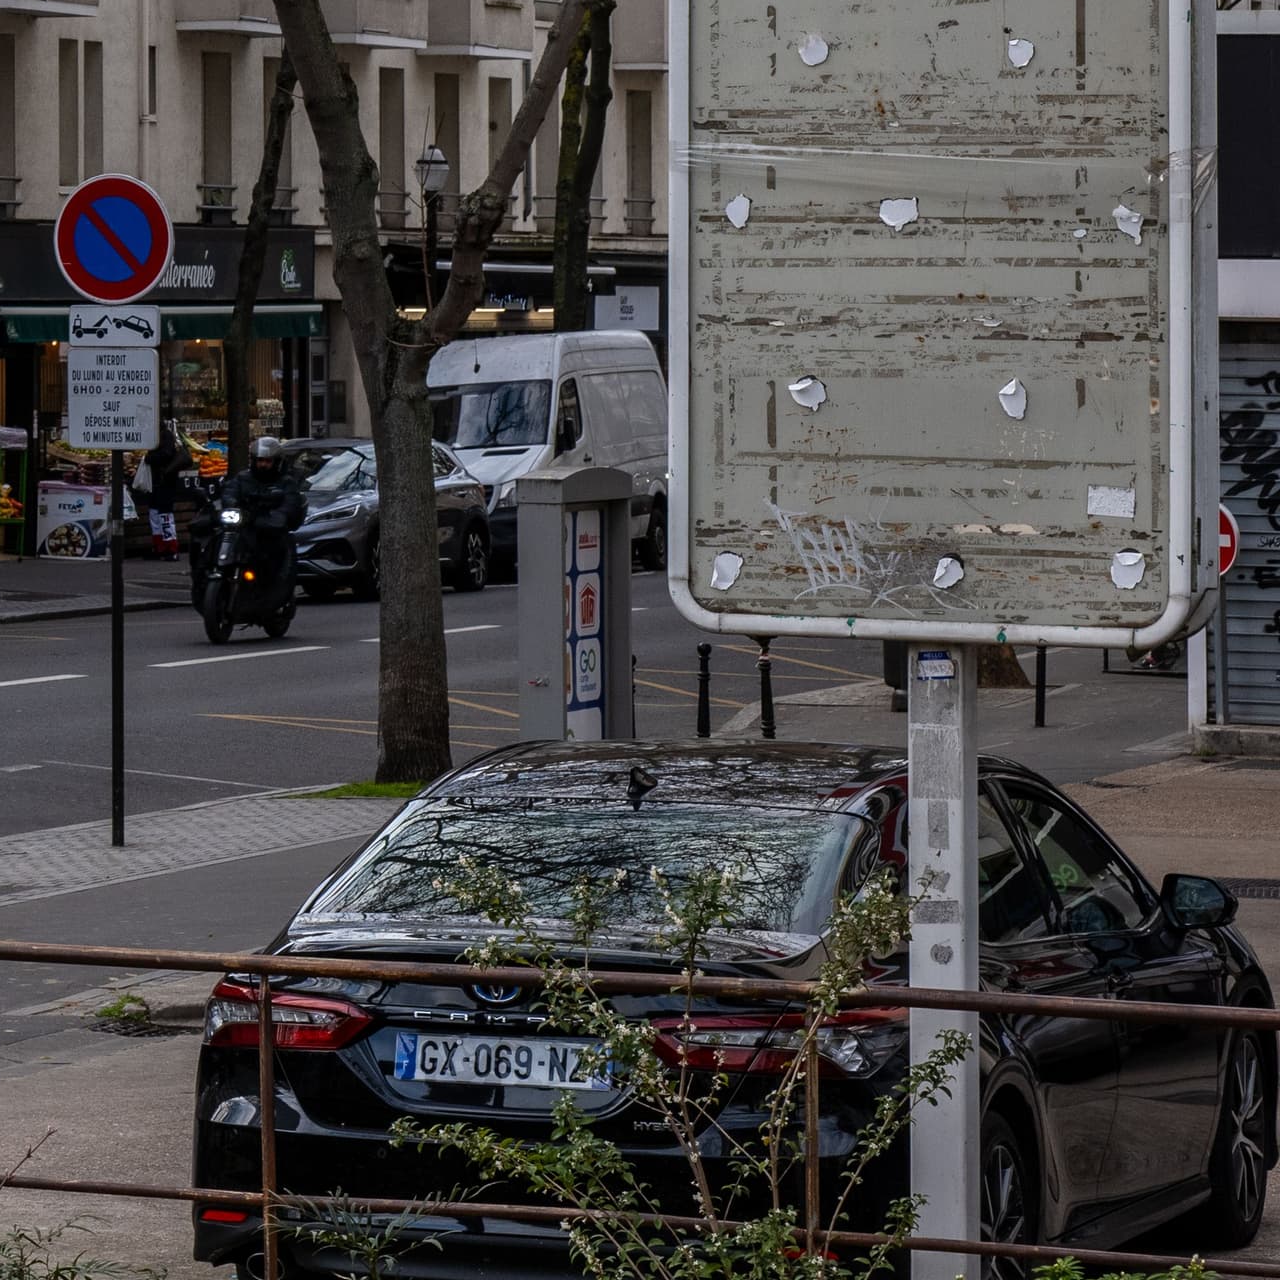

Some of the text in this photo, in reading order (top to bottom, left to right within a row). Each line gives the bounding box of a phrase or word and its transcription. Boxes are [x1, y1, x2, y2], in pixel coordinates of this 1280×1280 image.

[96, 355, 126, 366] INTERDIT
[72, 370, 151, 380] DU LUNDI AU VENDREDI
[73, 386, 102, 394] 6H00
[113, 386, 150, 395] 22H00
[103, 401, 120, 412] SAUF
[85, 413, 135, 427] DÉPOSE MINUT
[83, 432, 142, 443] 10 MINUTES MAXI
[580, 650, 596, 673] GO
[402, 1040, 588, 1082] F GX-069-NZ
